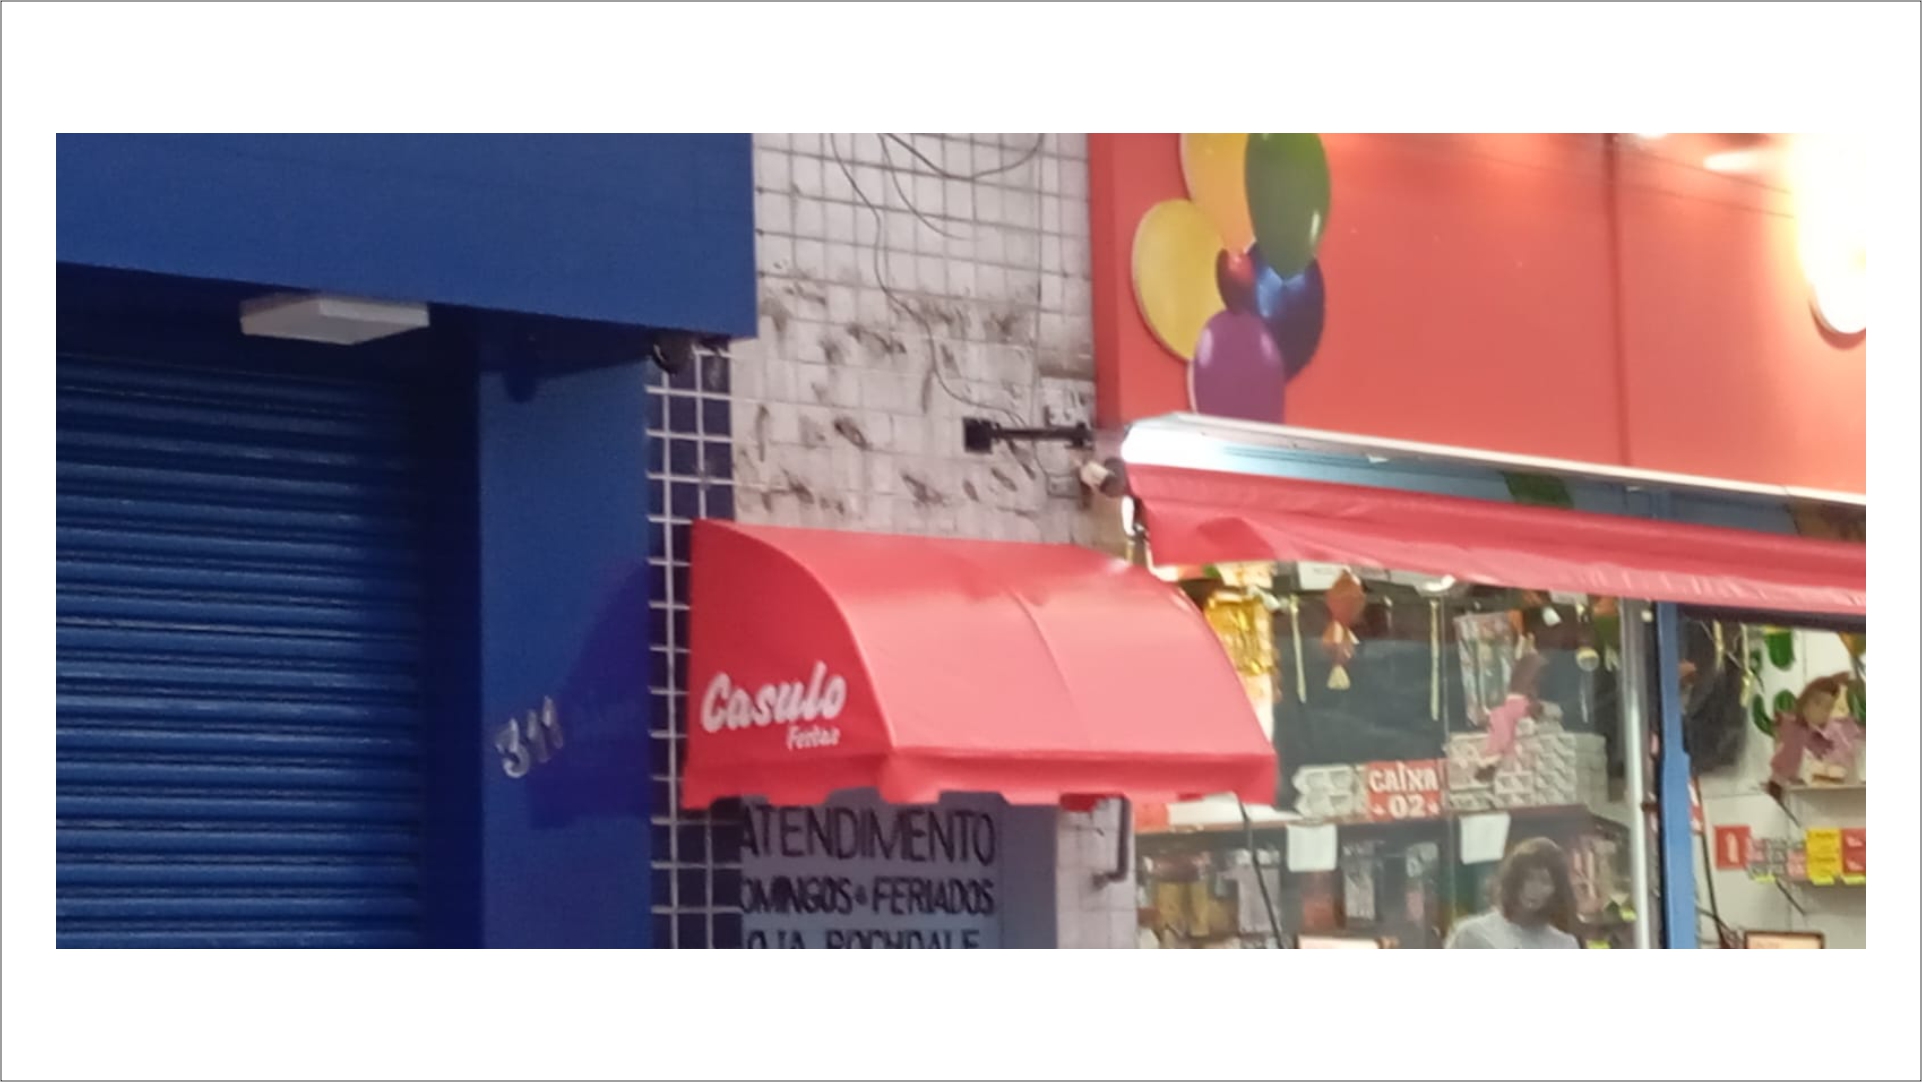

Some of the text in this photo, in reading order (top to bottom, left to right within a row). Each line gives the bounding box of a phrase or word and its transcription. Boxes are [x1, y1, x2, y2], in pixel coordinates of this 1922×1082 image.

[702, 660, 847, 733] Casulo
[496, 696, 563, 778] 311
[1369, 761, 1439, 793] CAIXA
[1389, 793, 1426, 819] 02
[742, 804, 996, 866] ATENDIMENTO
[741, 876, 852, 915] OMINGOS
[872, 876, 996, 916] FERIADOS
